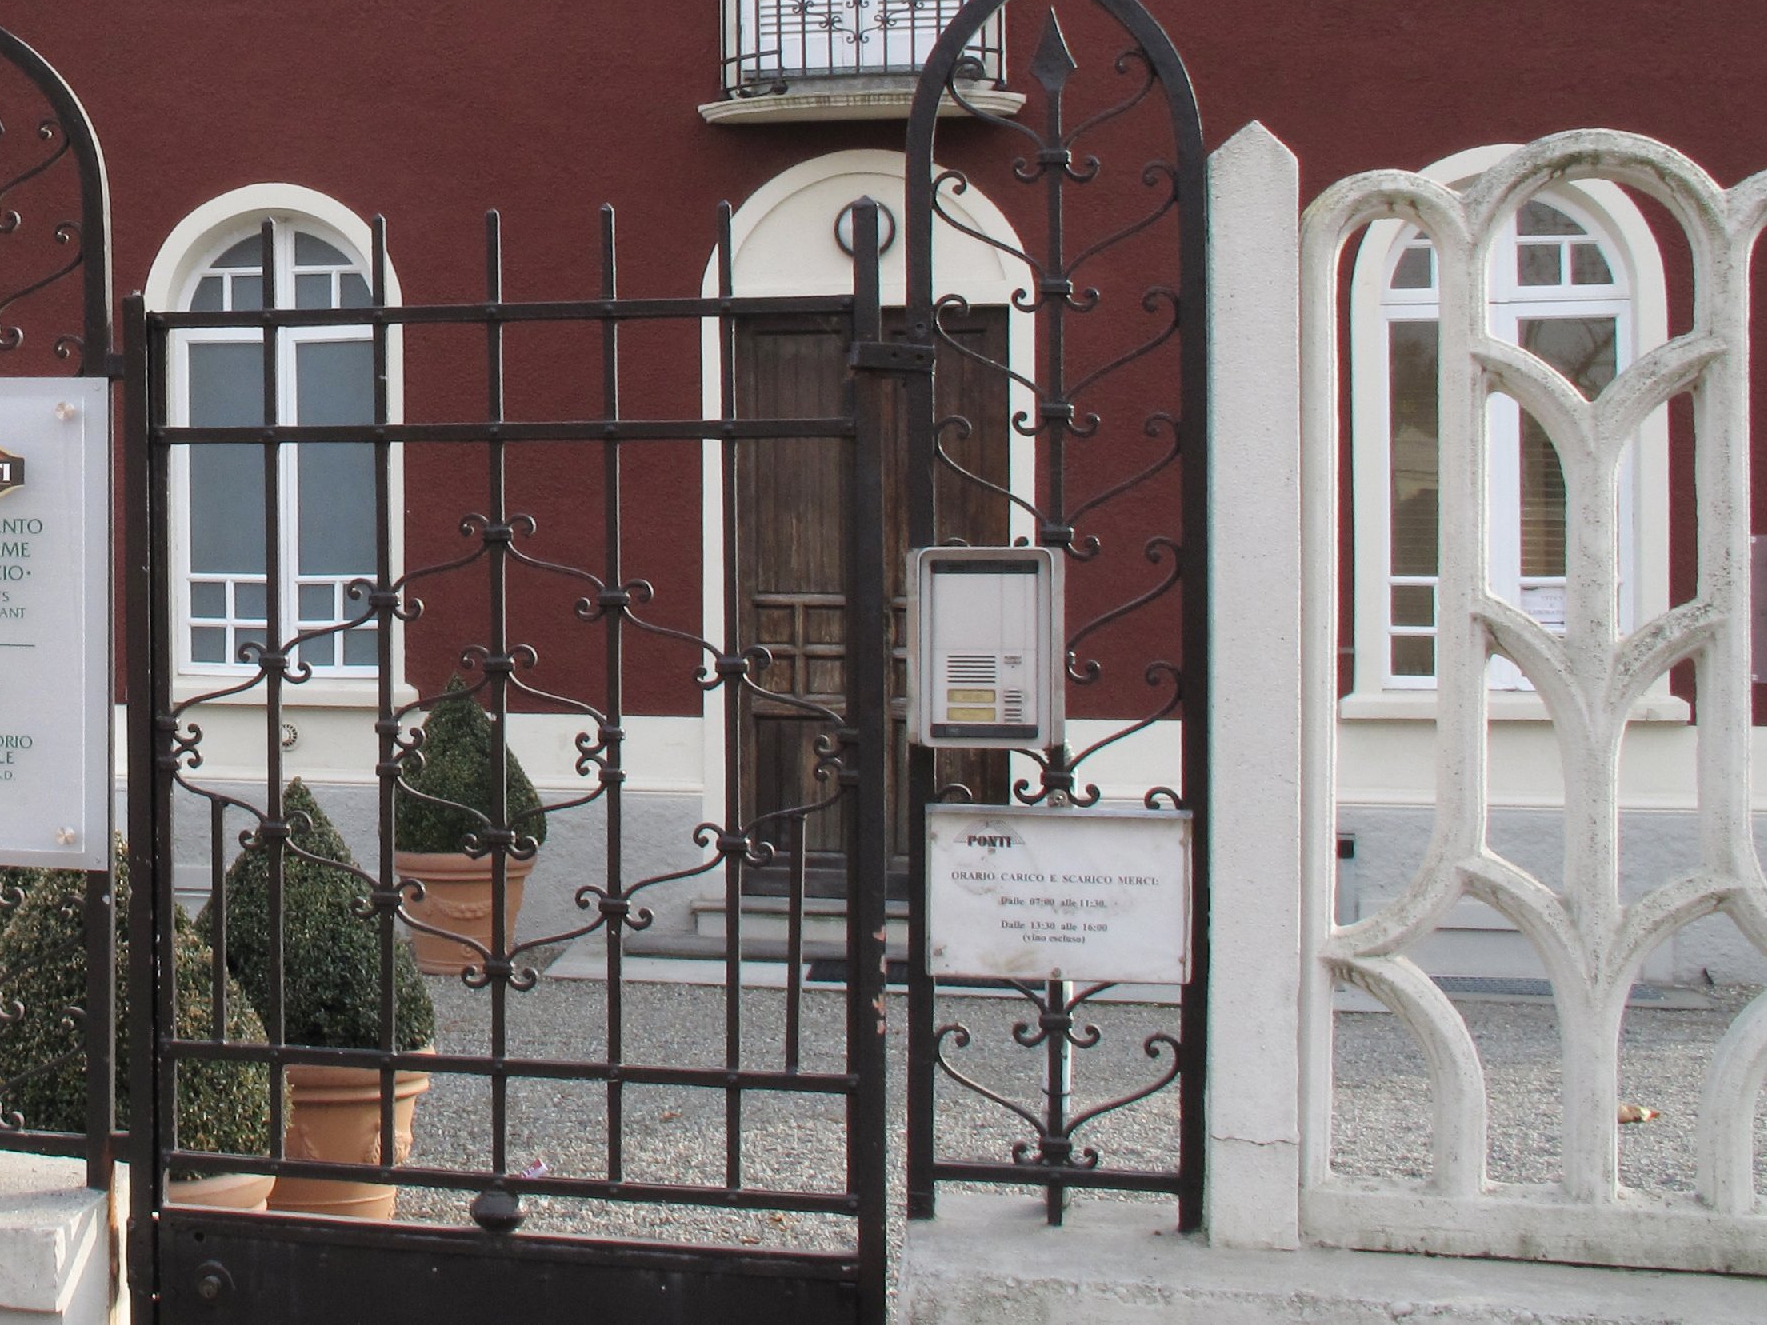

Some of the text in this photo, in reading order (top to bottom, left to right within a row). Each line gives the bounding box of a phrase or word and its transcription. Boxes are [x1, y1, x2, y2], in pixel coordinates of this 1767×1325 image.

[967, 835, 1011, 848] PONTI
[951, 872, 995, 881] ORARIO
[1001, 873, 1045, 882] CARICO
[1062, 875, 1112, 884] SCARICO
[1001, 896, 1025, 905] Dalle
[1061, 898, 1077, 907] alle
[1001, 920, 1025, 929] Dalle
[1030, 921, 1055, 930] 13:30
[1061, 922, 1077, 931] alle
